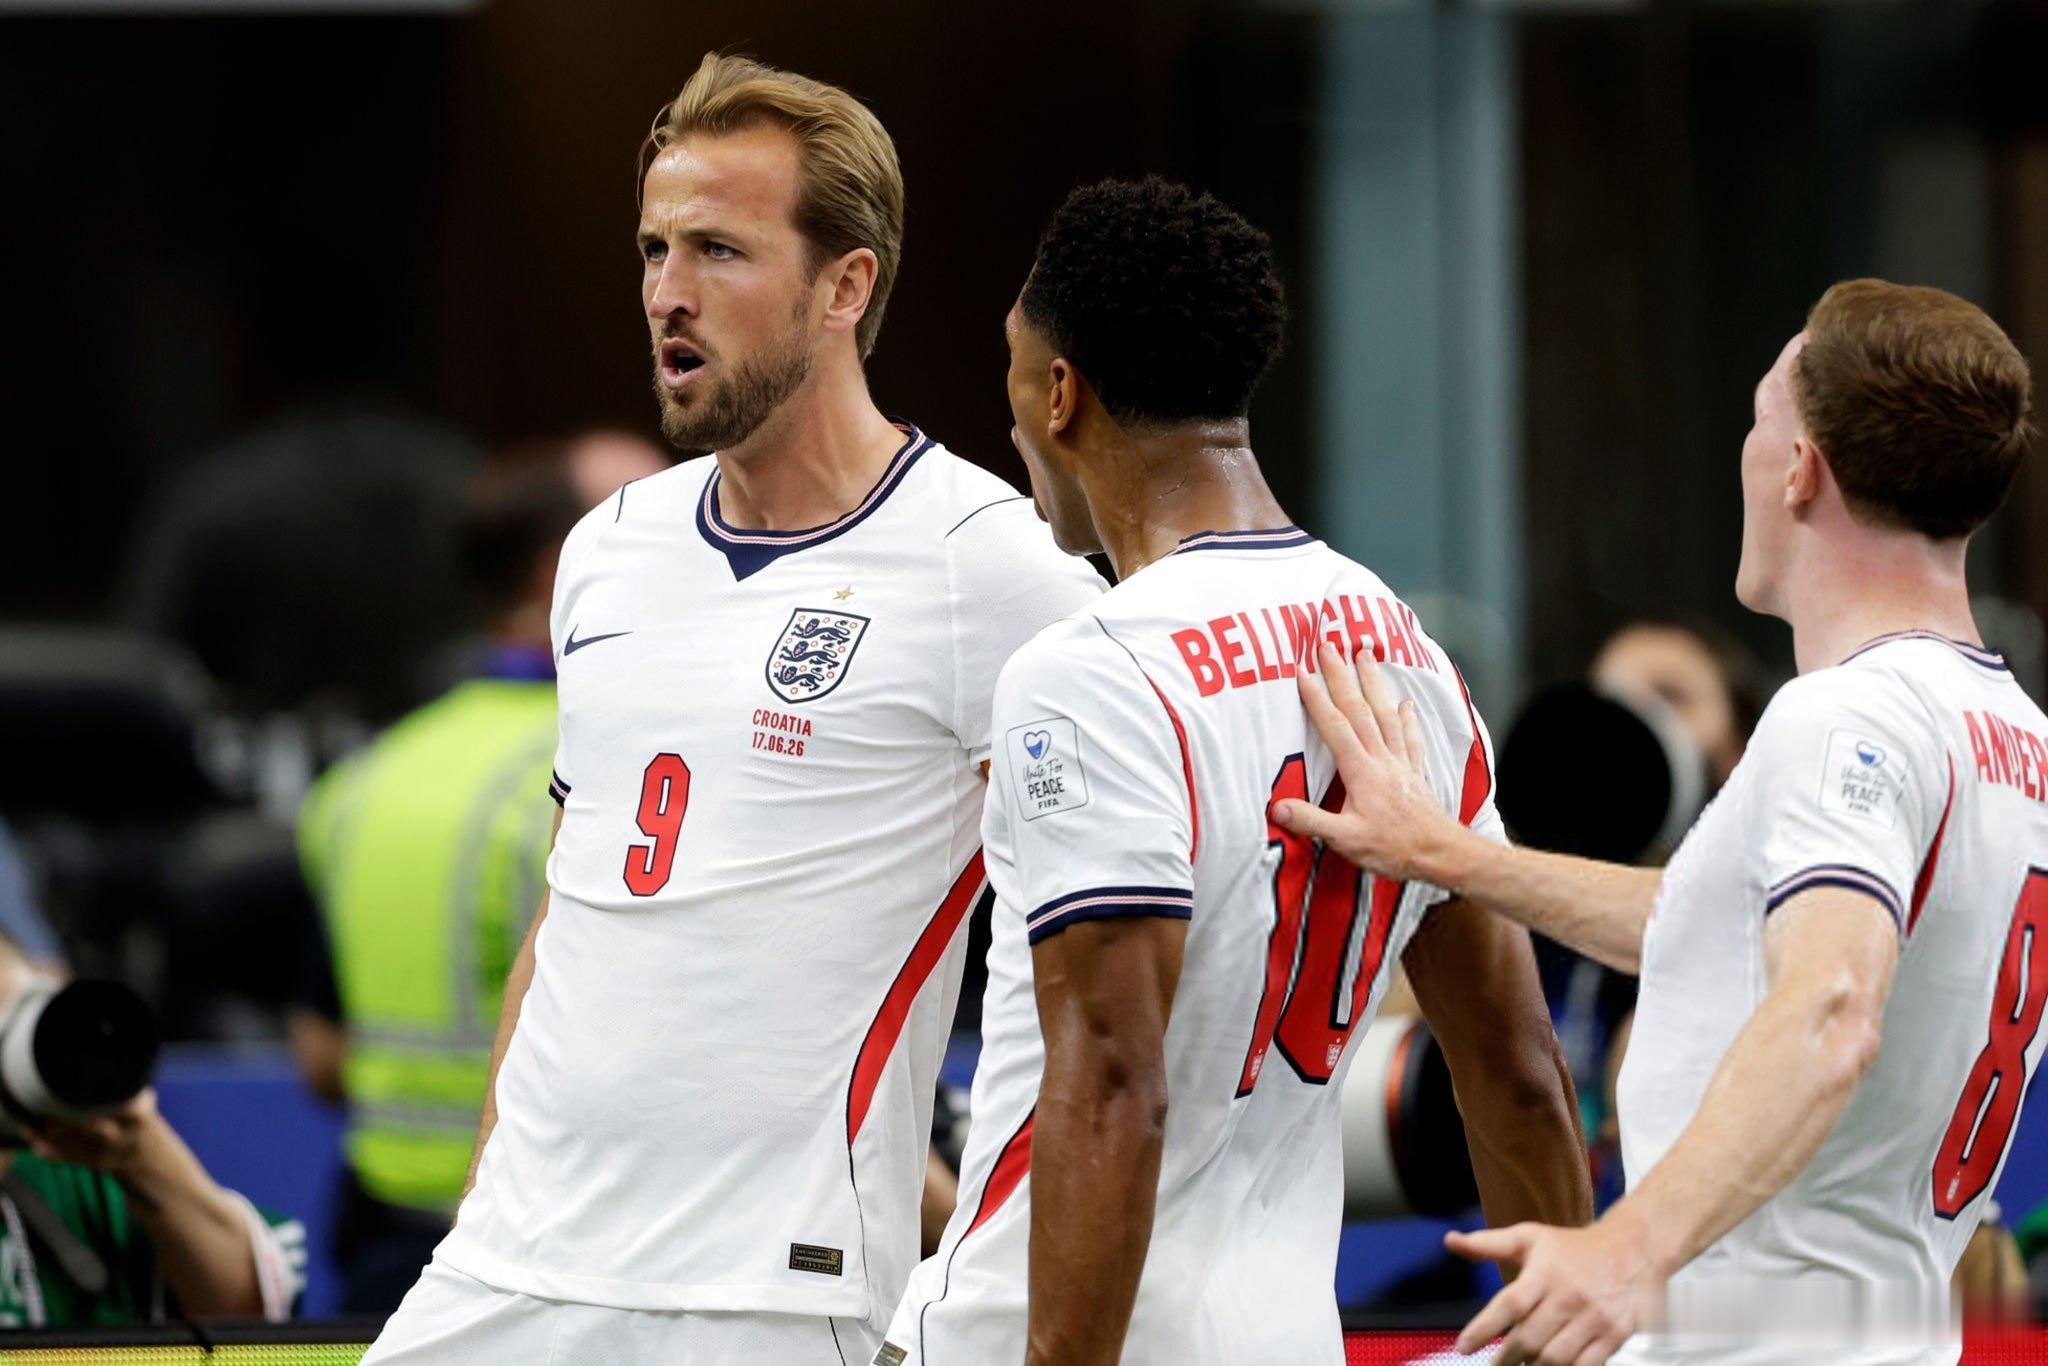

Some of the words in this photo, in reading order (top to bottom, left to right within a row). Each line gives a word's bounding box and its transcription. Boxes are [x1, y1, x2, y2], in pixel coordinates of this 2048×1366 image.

[752, 709, 812, 737] CROATIA
[752, 731, 805, 757] 17.06.26
[1963, 710, 2048, 804] ANDER
[1028, 777, 1066, 800] PEACE
[1038, 798, 1060, 810] FIFA
[623, 752, 691, 897] 9
[1234, 751, 1408, 1100] 10
[1932, 864, 2048, 1221] 8
